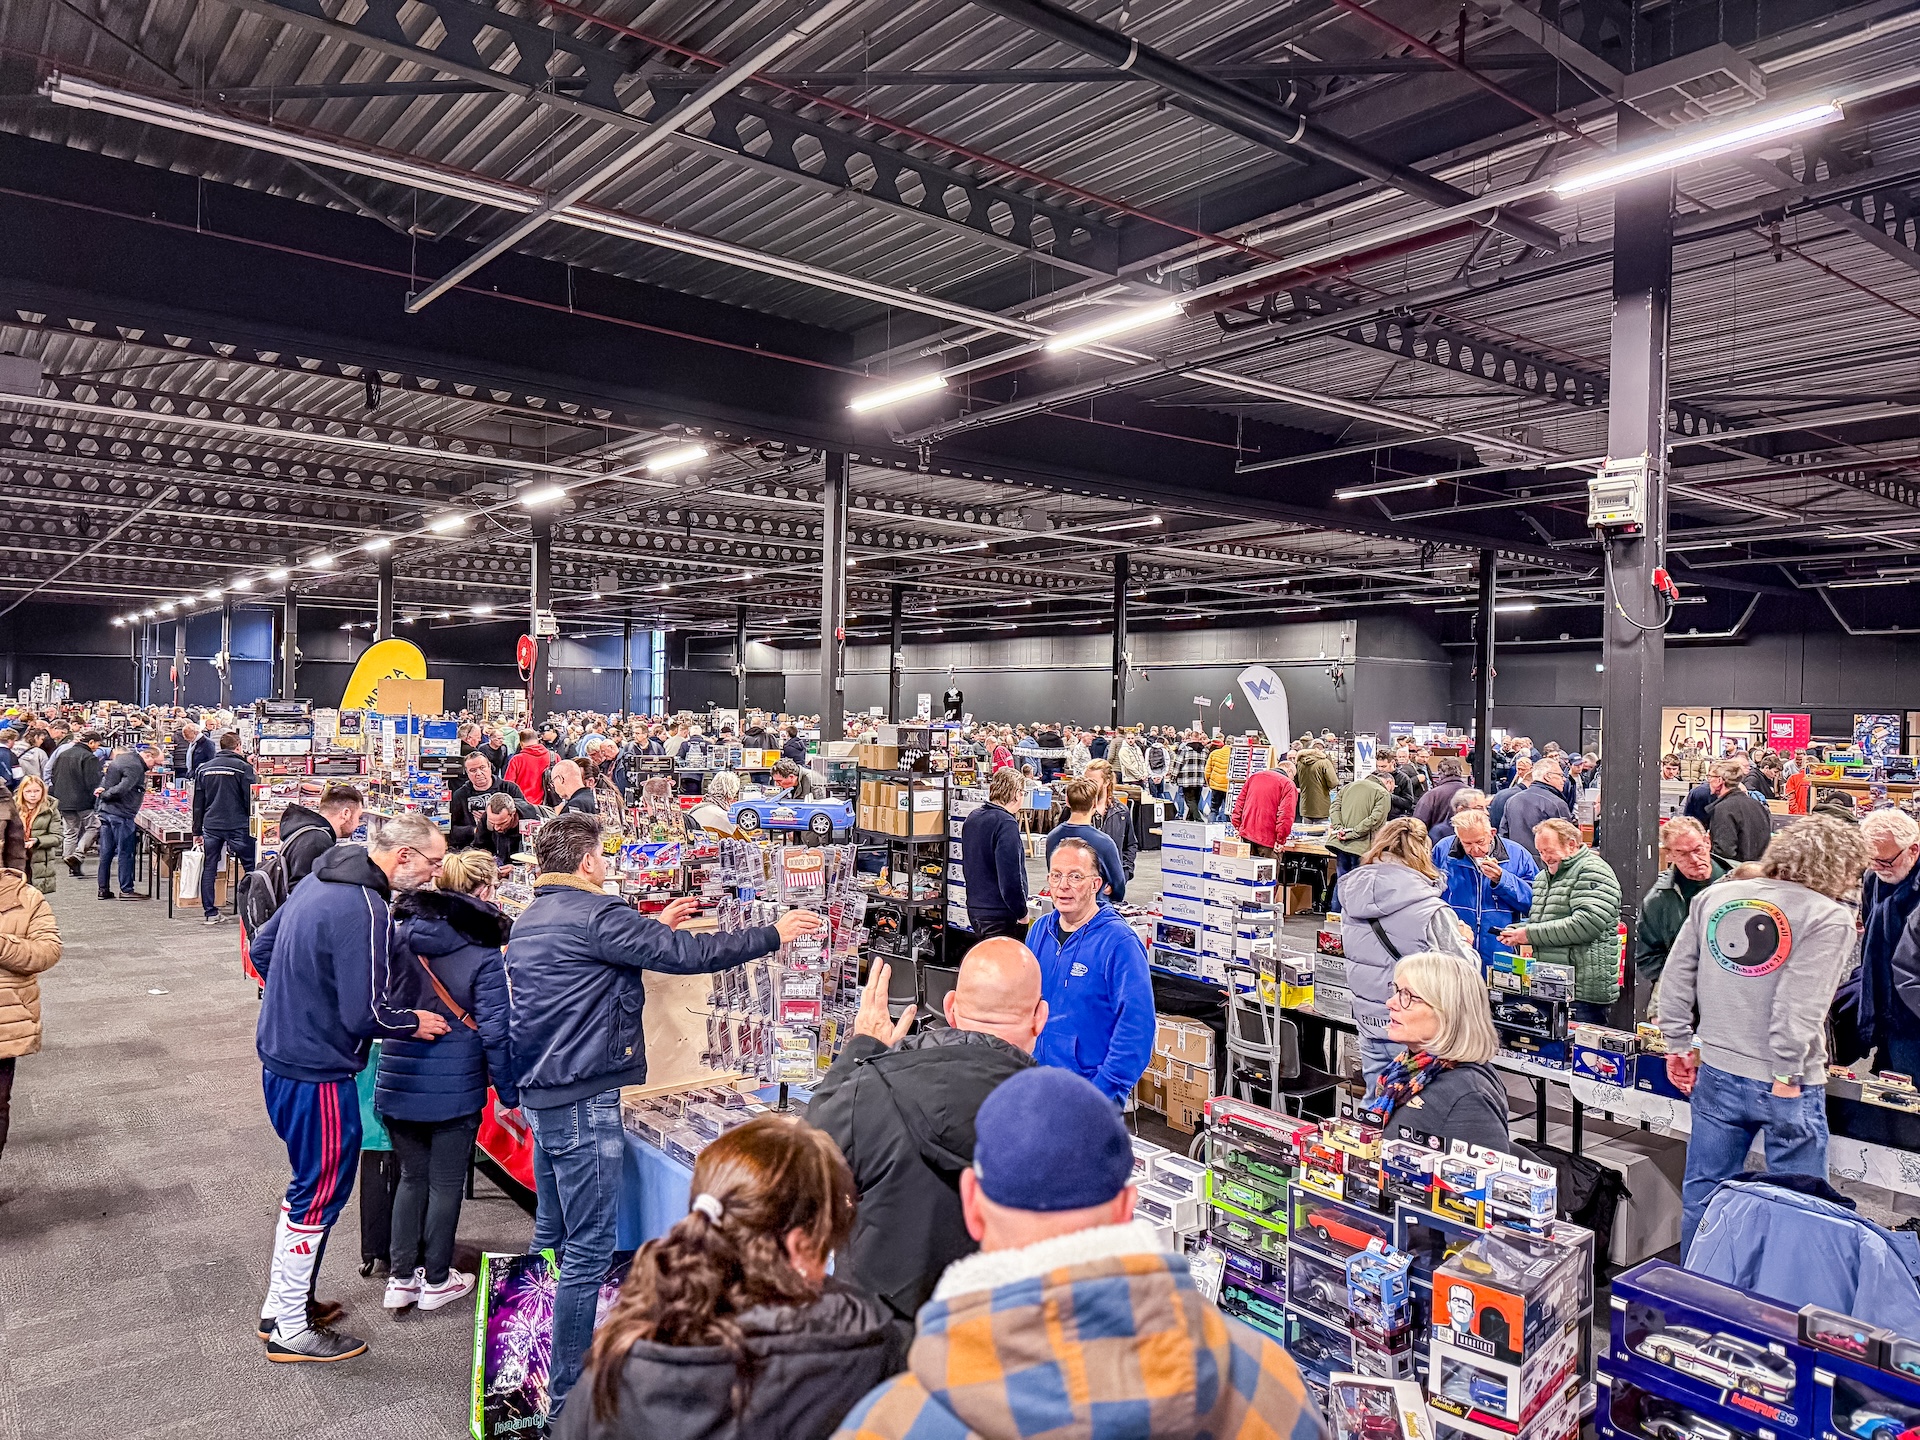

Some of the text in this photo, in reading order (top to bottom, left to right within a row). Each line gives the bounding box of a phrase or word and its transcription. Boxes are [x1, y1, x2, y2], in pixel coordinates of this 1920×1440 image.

[1171, 832, 1196, 840] MODELCAR
[1170, 858, 1194, 866] MODELCAR
[1171, 883, 1197, 891] MODELCAR
[1171, 907, 1196, 915] MODELCAR
[1361, 1014, 1390, 1029] EQUALIT
